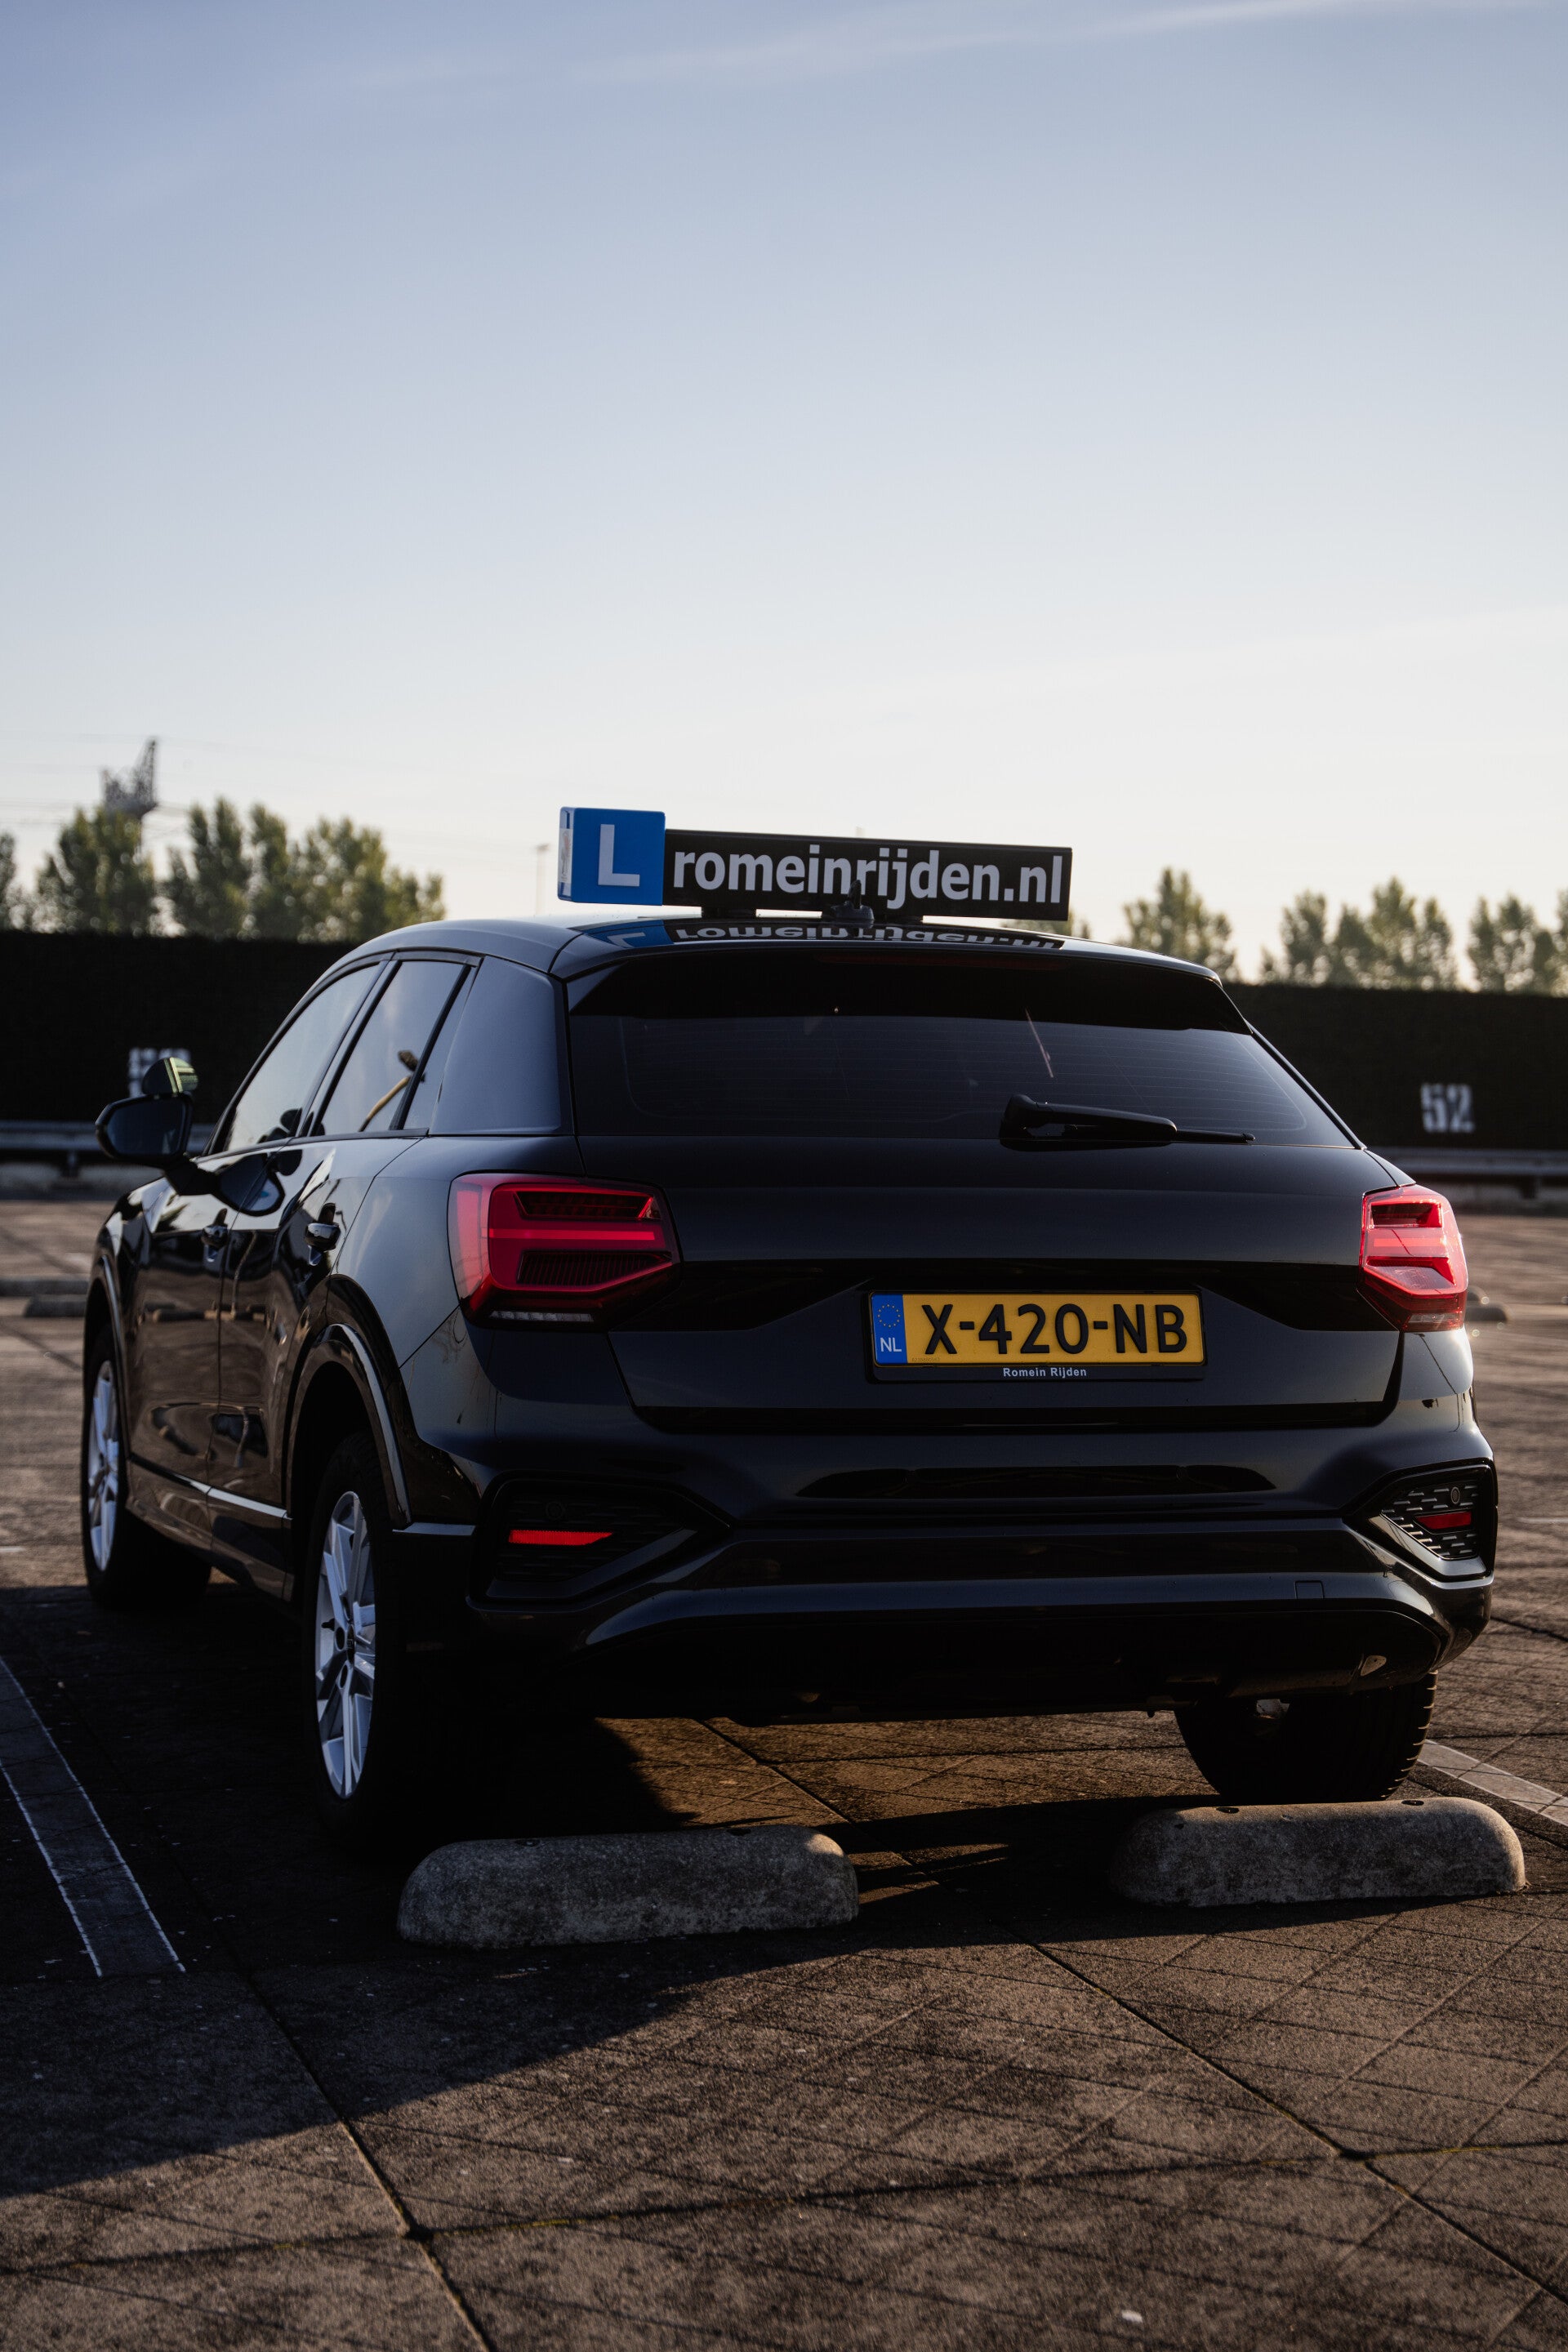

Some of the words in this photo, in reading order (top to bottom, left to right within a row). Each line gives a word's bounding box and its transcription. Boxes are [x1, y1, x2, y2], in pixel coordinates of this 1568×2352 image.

[598, 824, 640, 887] L
[673, 844, 1062, 909] romeinrijden.nl
[1421, 1083, 1474, 1133] 52
[880, 1337, 902, 1353] NL
[921, 1303, 1187, 1355] X-420-NB
[1003, 1367, 1046, 1377] Romein
[1050, 1367, 1087, 1379] Rijden
